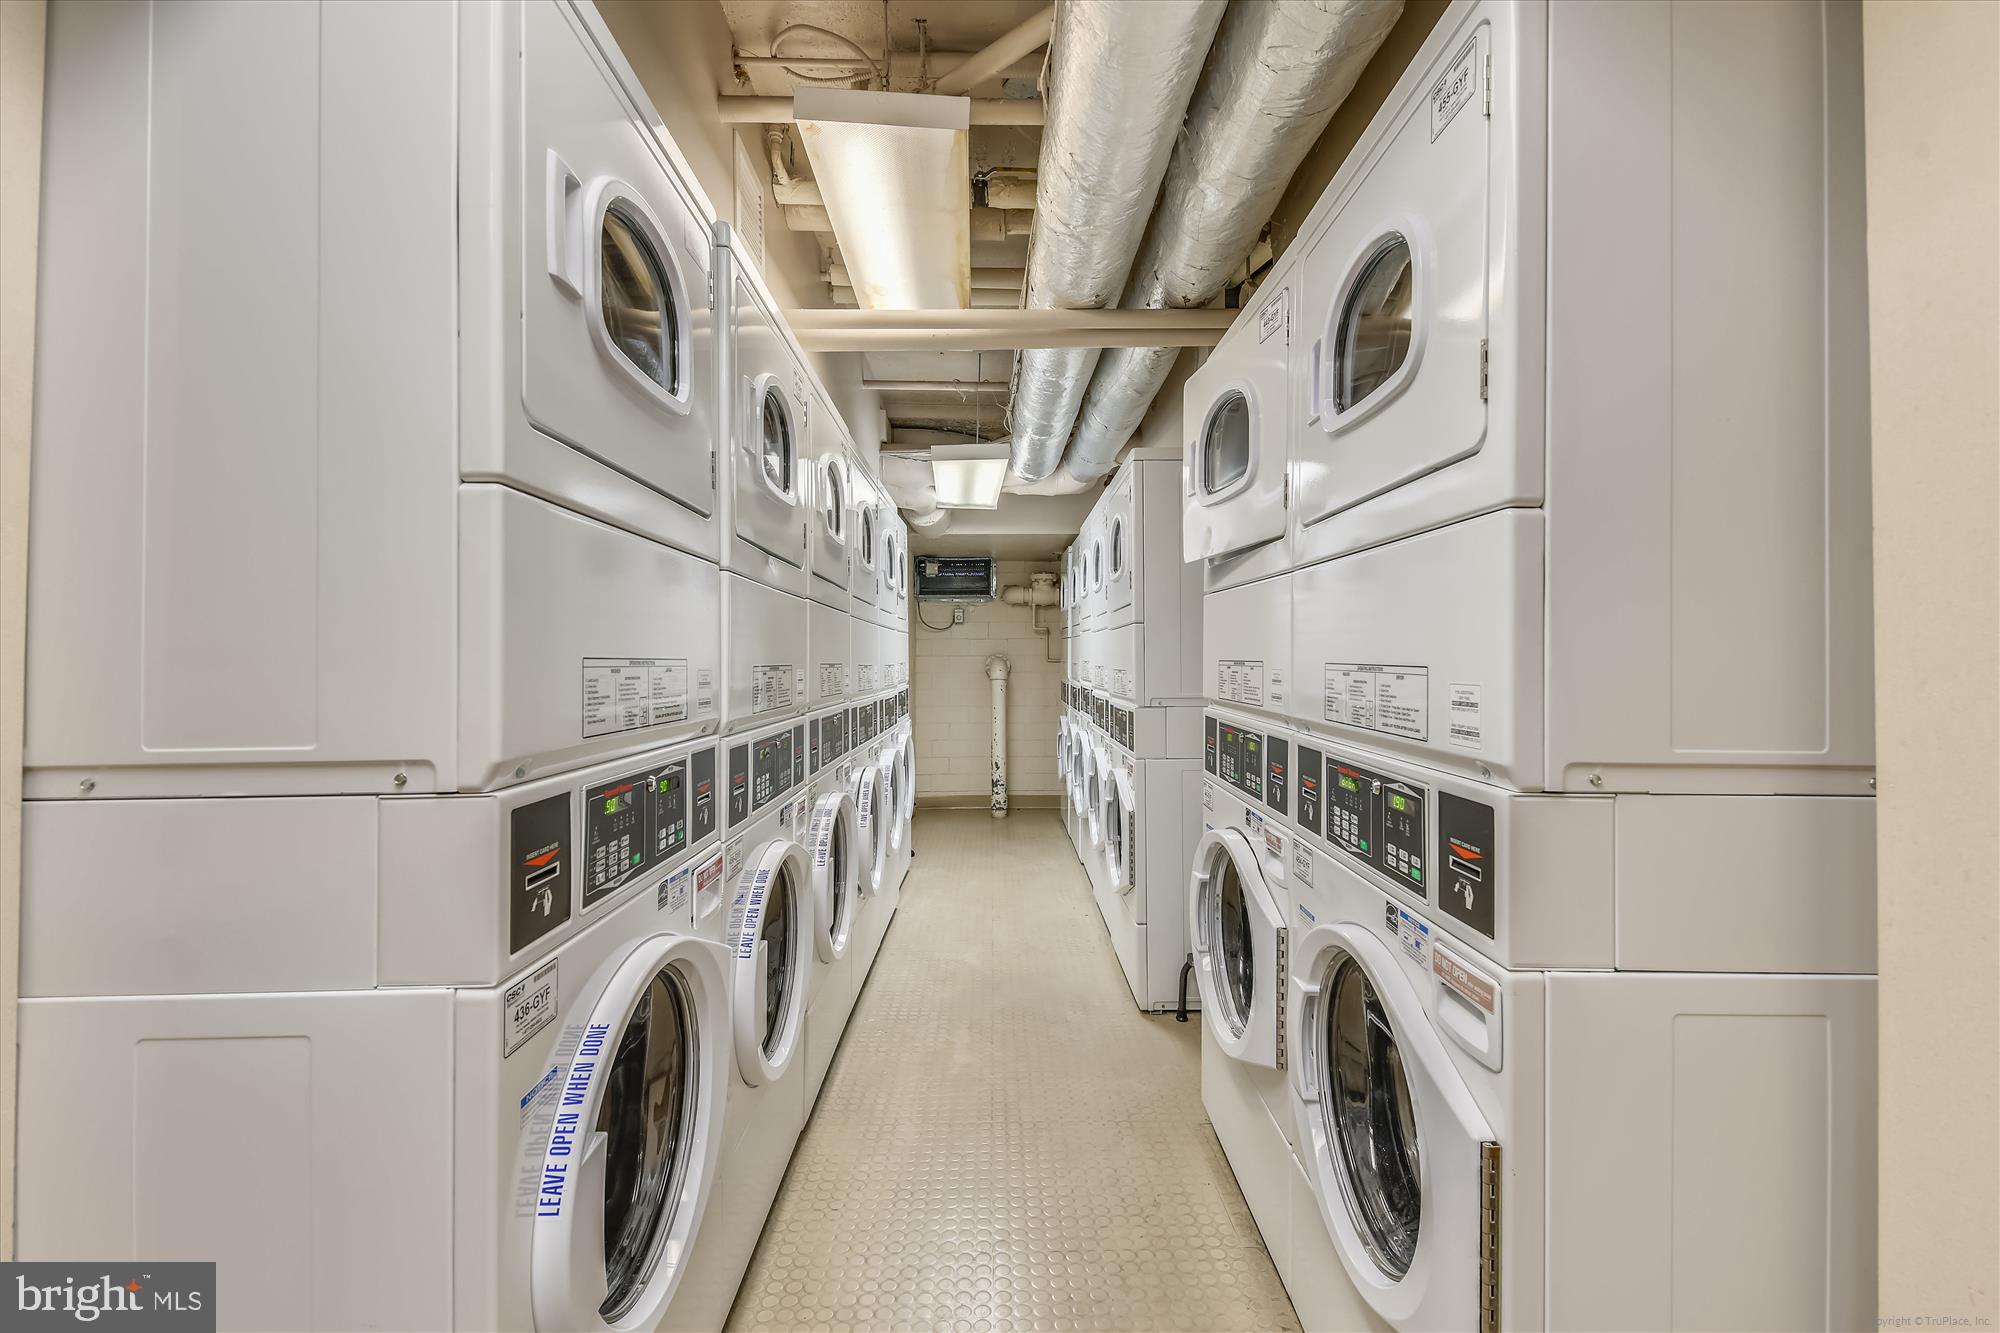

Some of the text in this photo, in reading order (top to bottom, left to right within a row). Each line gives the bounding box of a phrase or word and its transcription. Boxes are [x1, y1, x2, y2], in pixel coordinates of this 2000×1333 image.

[817, 848, 827, 867] LEAVE
[755, 869, 771, 884] DONE
[749, 885, 765, 906] WHEN
[744, 908, 760, 929] OPEN
[738, 931, 755, 959] LEAVE
[1441, 956, 1452, 974] NOT
[1452, 964, 1468, 985] OPEN
[514, 985, 551, 1023] 436-GYF
[537, 1023, 610, 1217] LEAVE OPEN WHEN DONE
